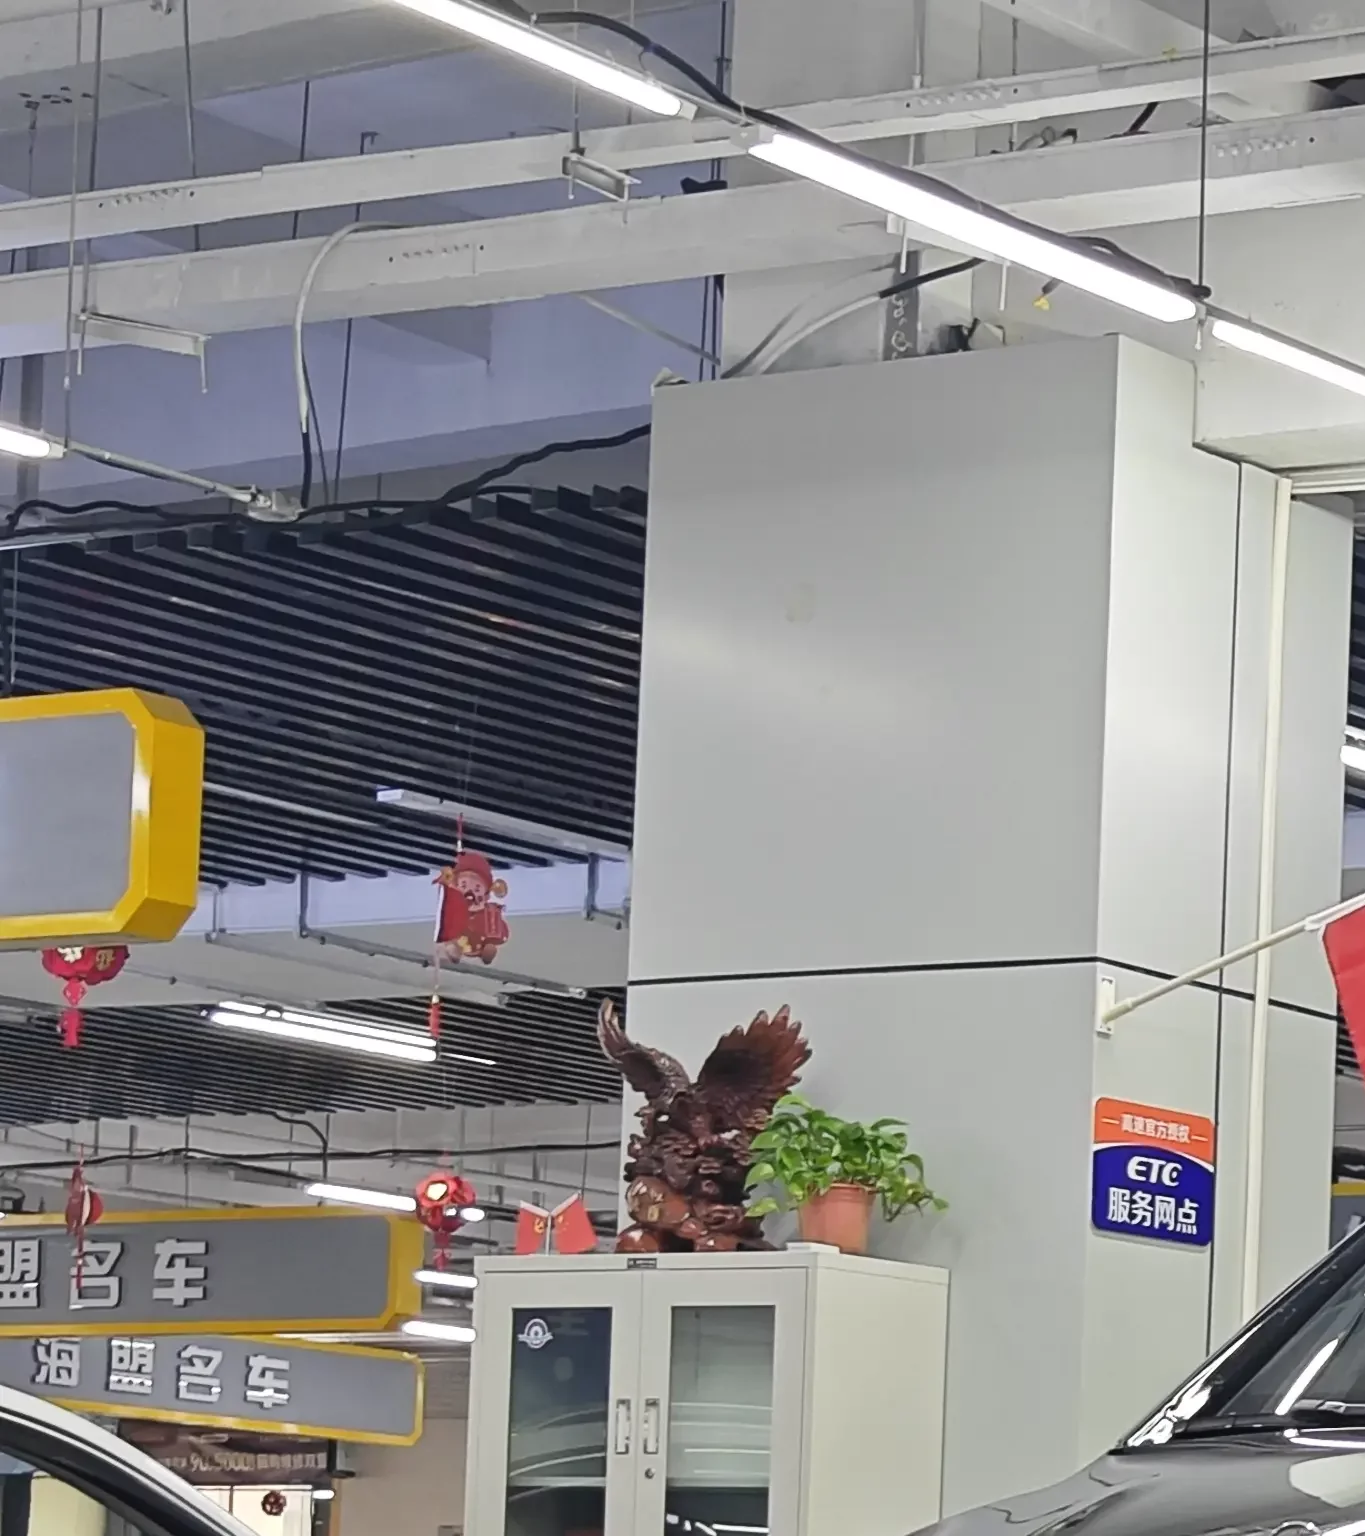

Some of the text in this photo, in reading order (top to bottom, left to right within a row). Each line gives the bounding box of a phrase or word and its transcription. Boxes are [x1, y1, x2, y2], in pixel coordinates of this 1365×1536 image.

[1126, 1155, 1183, 1187] ETC
[1107, 1187, 1199, 1235] 服务网点
[0, 1238, 207, 1310] 盟名车
[32, 1336, 290, 1409] 海盟名车
